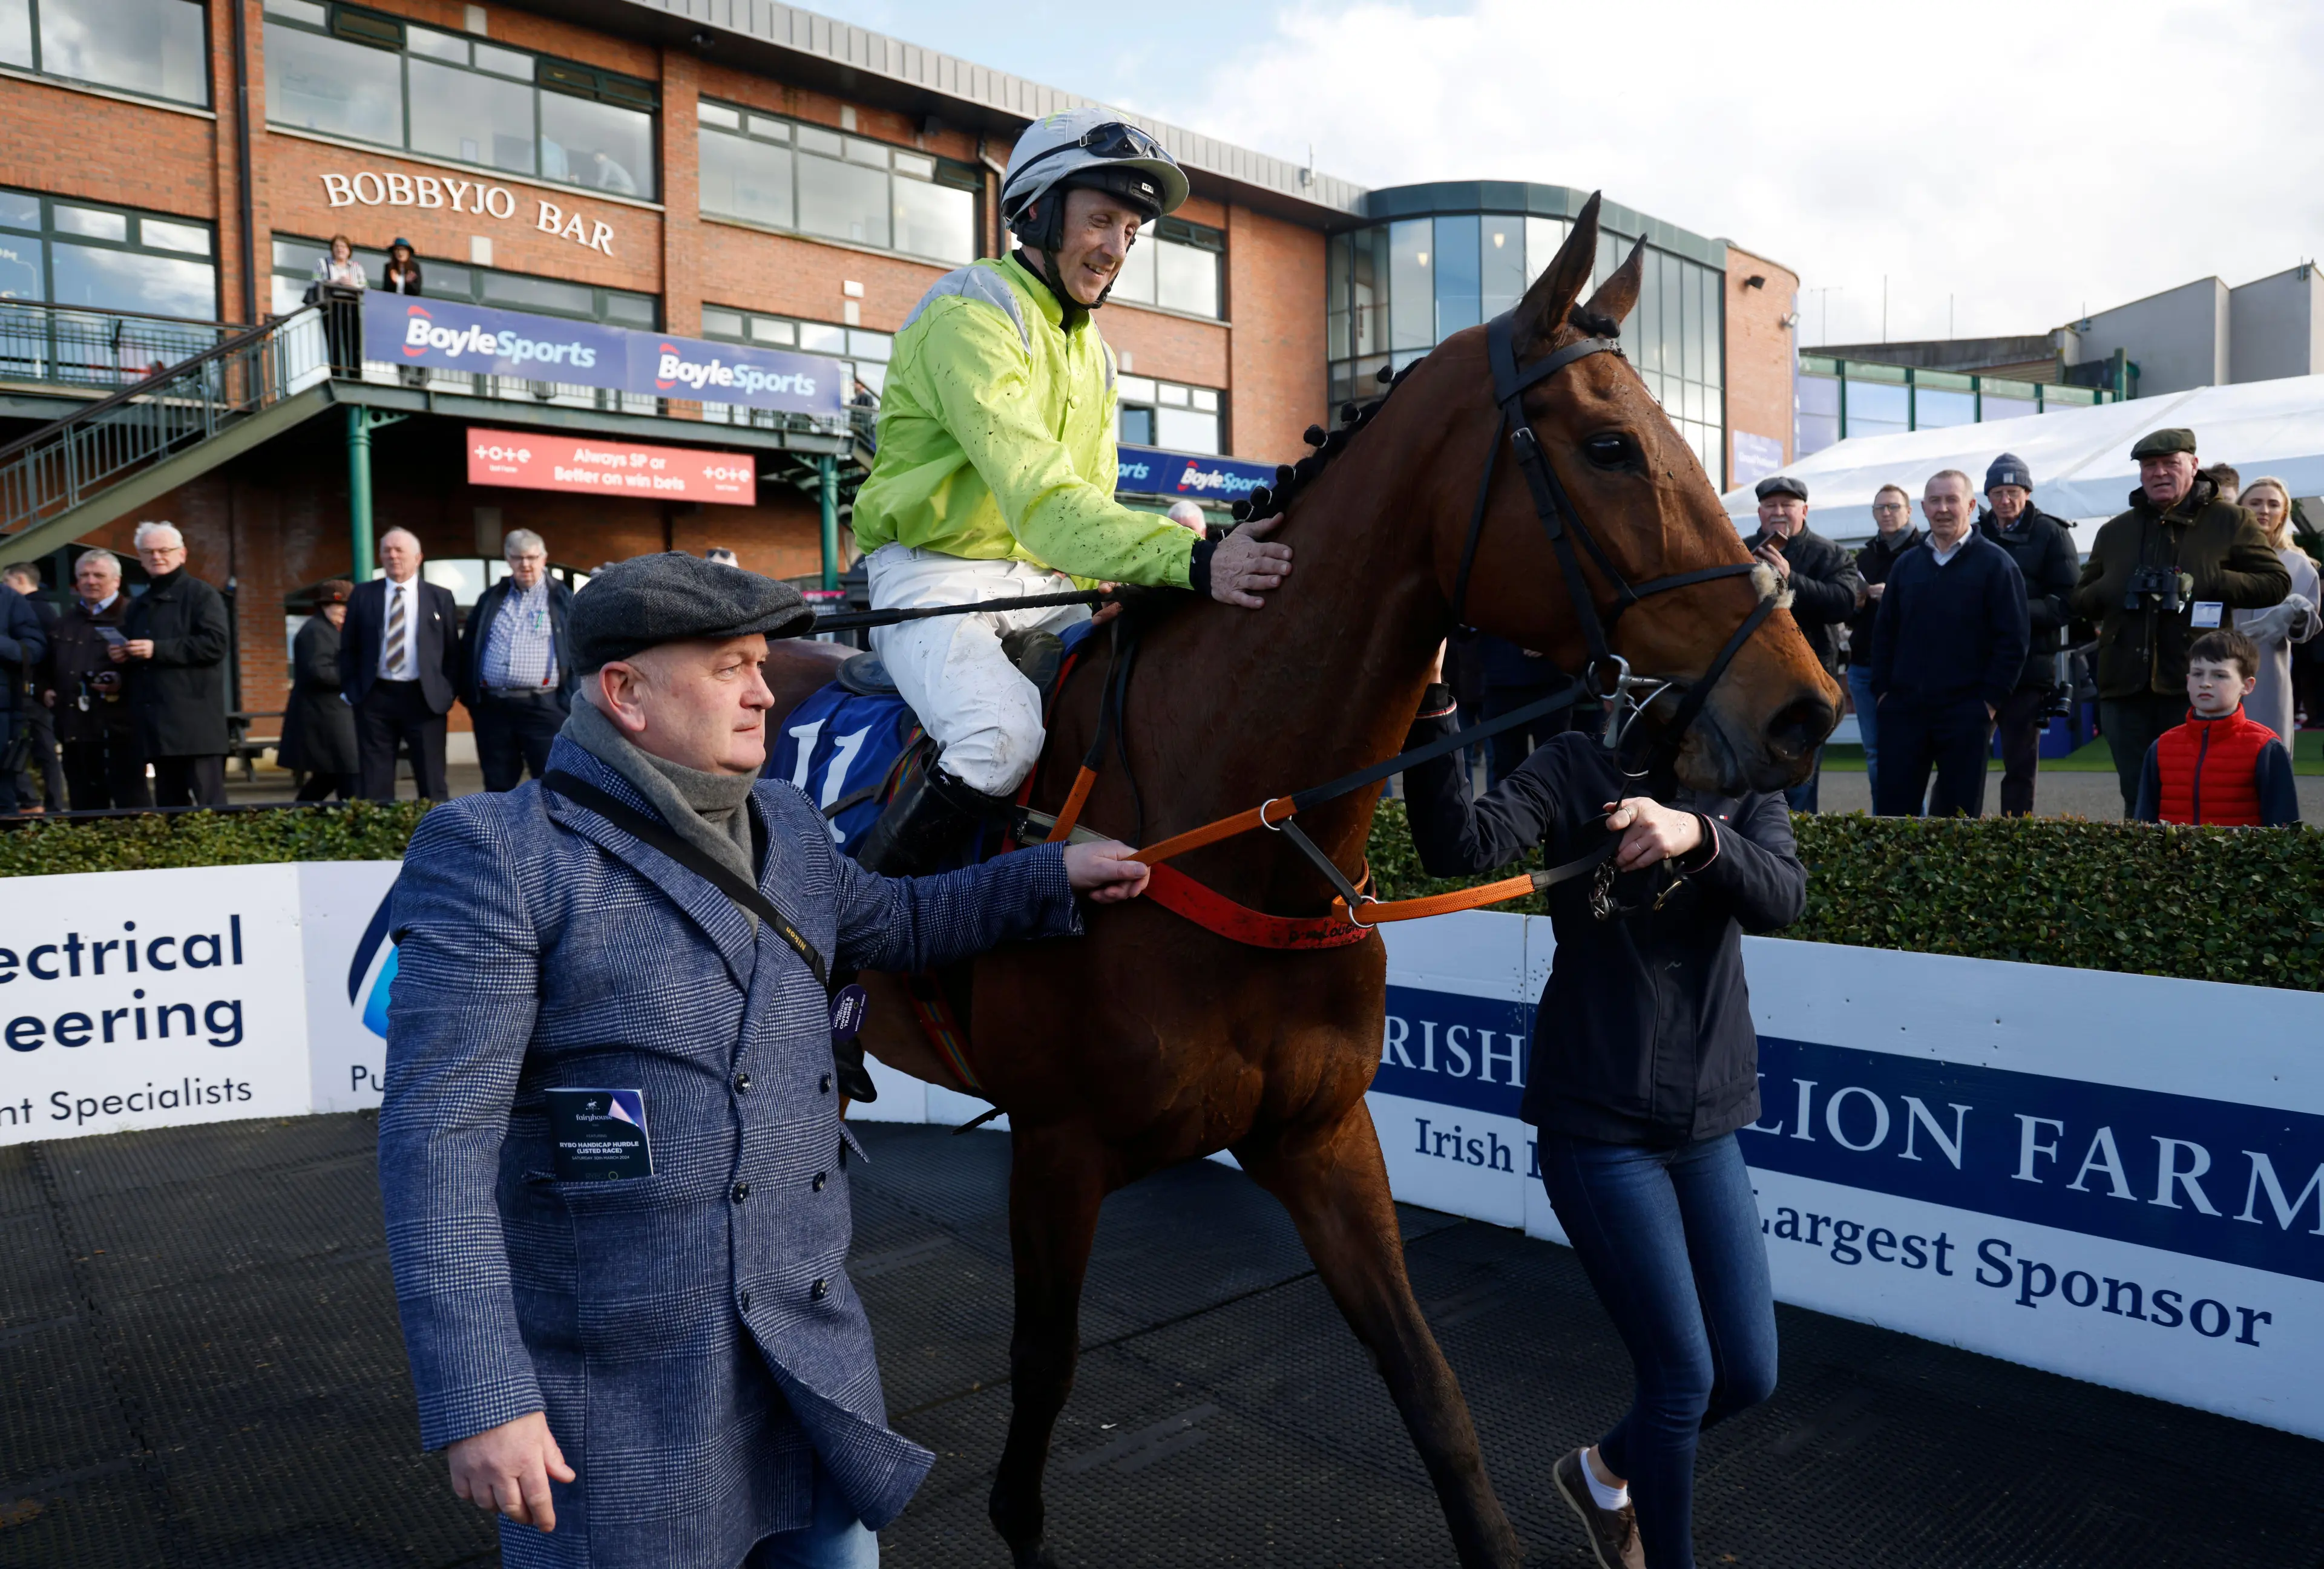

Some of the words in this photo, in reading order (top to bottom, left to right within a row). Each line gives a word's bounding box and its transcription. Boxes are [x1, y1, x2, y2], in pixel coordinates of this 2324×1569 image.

[319, 171, 516, 220] BOBBYJO
[536, 200, 615, 257] BAR
[405, 318, 597, 368] BoyleSports
[658, 354, 816, 396] BoyleSports
[554, 465, 600, 483] Better
[602, 473, 623, 486] on
[625, 473, 651, 488] win
[654, 474, 685, 491] bets
[573, 448, 627, 468] Always
[629, 453, 648, 468] SP
[649, 458, 666, 470] or
[789, 718, 873, 843] 11
[786, 926, 806, 951] Nikon
[5, 989, 243, 1052] eering
[840, 1003, 849, 1029] OWNERS
[844, 998, 854, 1027] TRAINERS
[50, 1078, 252, 1126] Specialists
[2011, 1113, 2324, 1236] FARM
[1415, 1118, 1514, 1174] Irish
[1975, 1238, 2273, 1348] Sponsor
